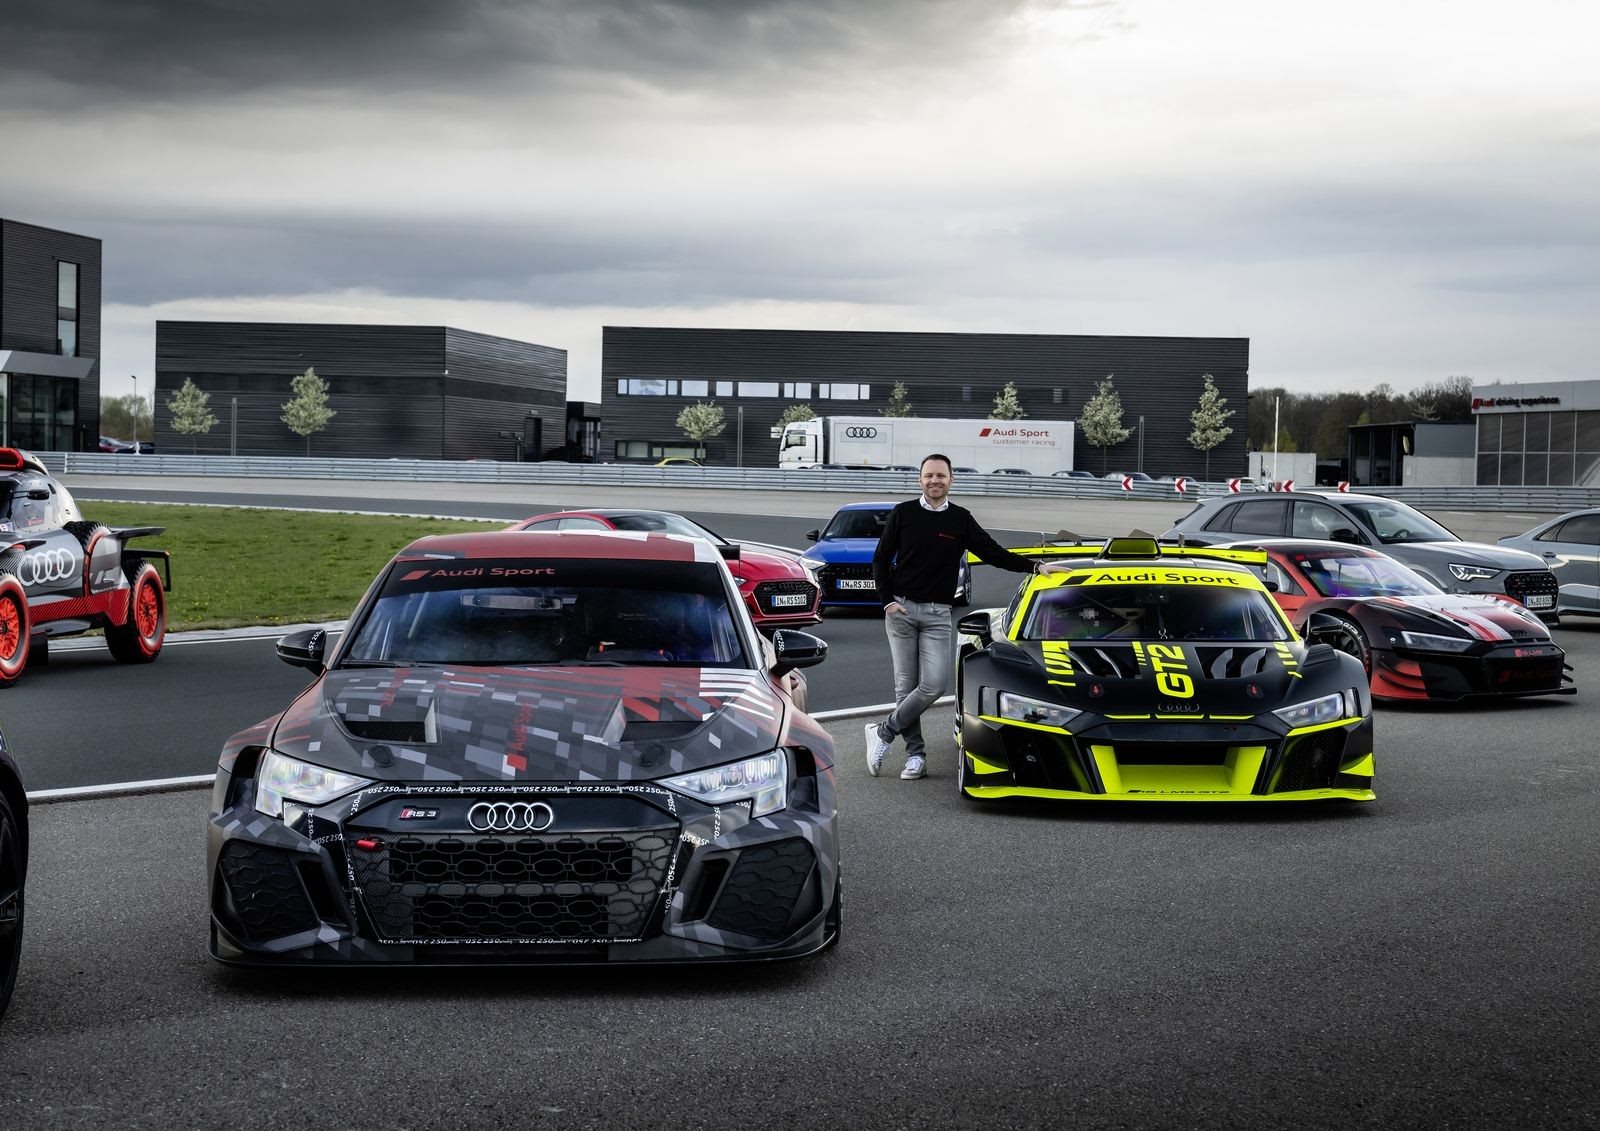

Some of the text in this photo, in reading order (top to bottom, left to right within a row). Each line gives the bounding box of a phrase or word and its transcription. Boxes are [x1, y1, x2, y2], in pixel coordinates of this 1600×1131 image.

[1496, 397, 1521, 408] driving
[1521, 395, 1560, 407] experience
[993, 428, 1050, 438] Audi Sport
[1032, 439, 1056, 447] racing
[431, 567, 556, 577] Audi Sport
[1095, 572, 1240, 585] Audi Sport
[841, 580, 850, 589] IN
[853, 580, 862, 589] RS
[1146, 644, 1195, 699] GT2
[426, 810, 437, 818] 3
